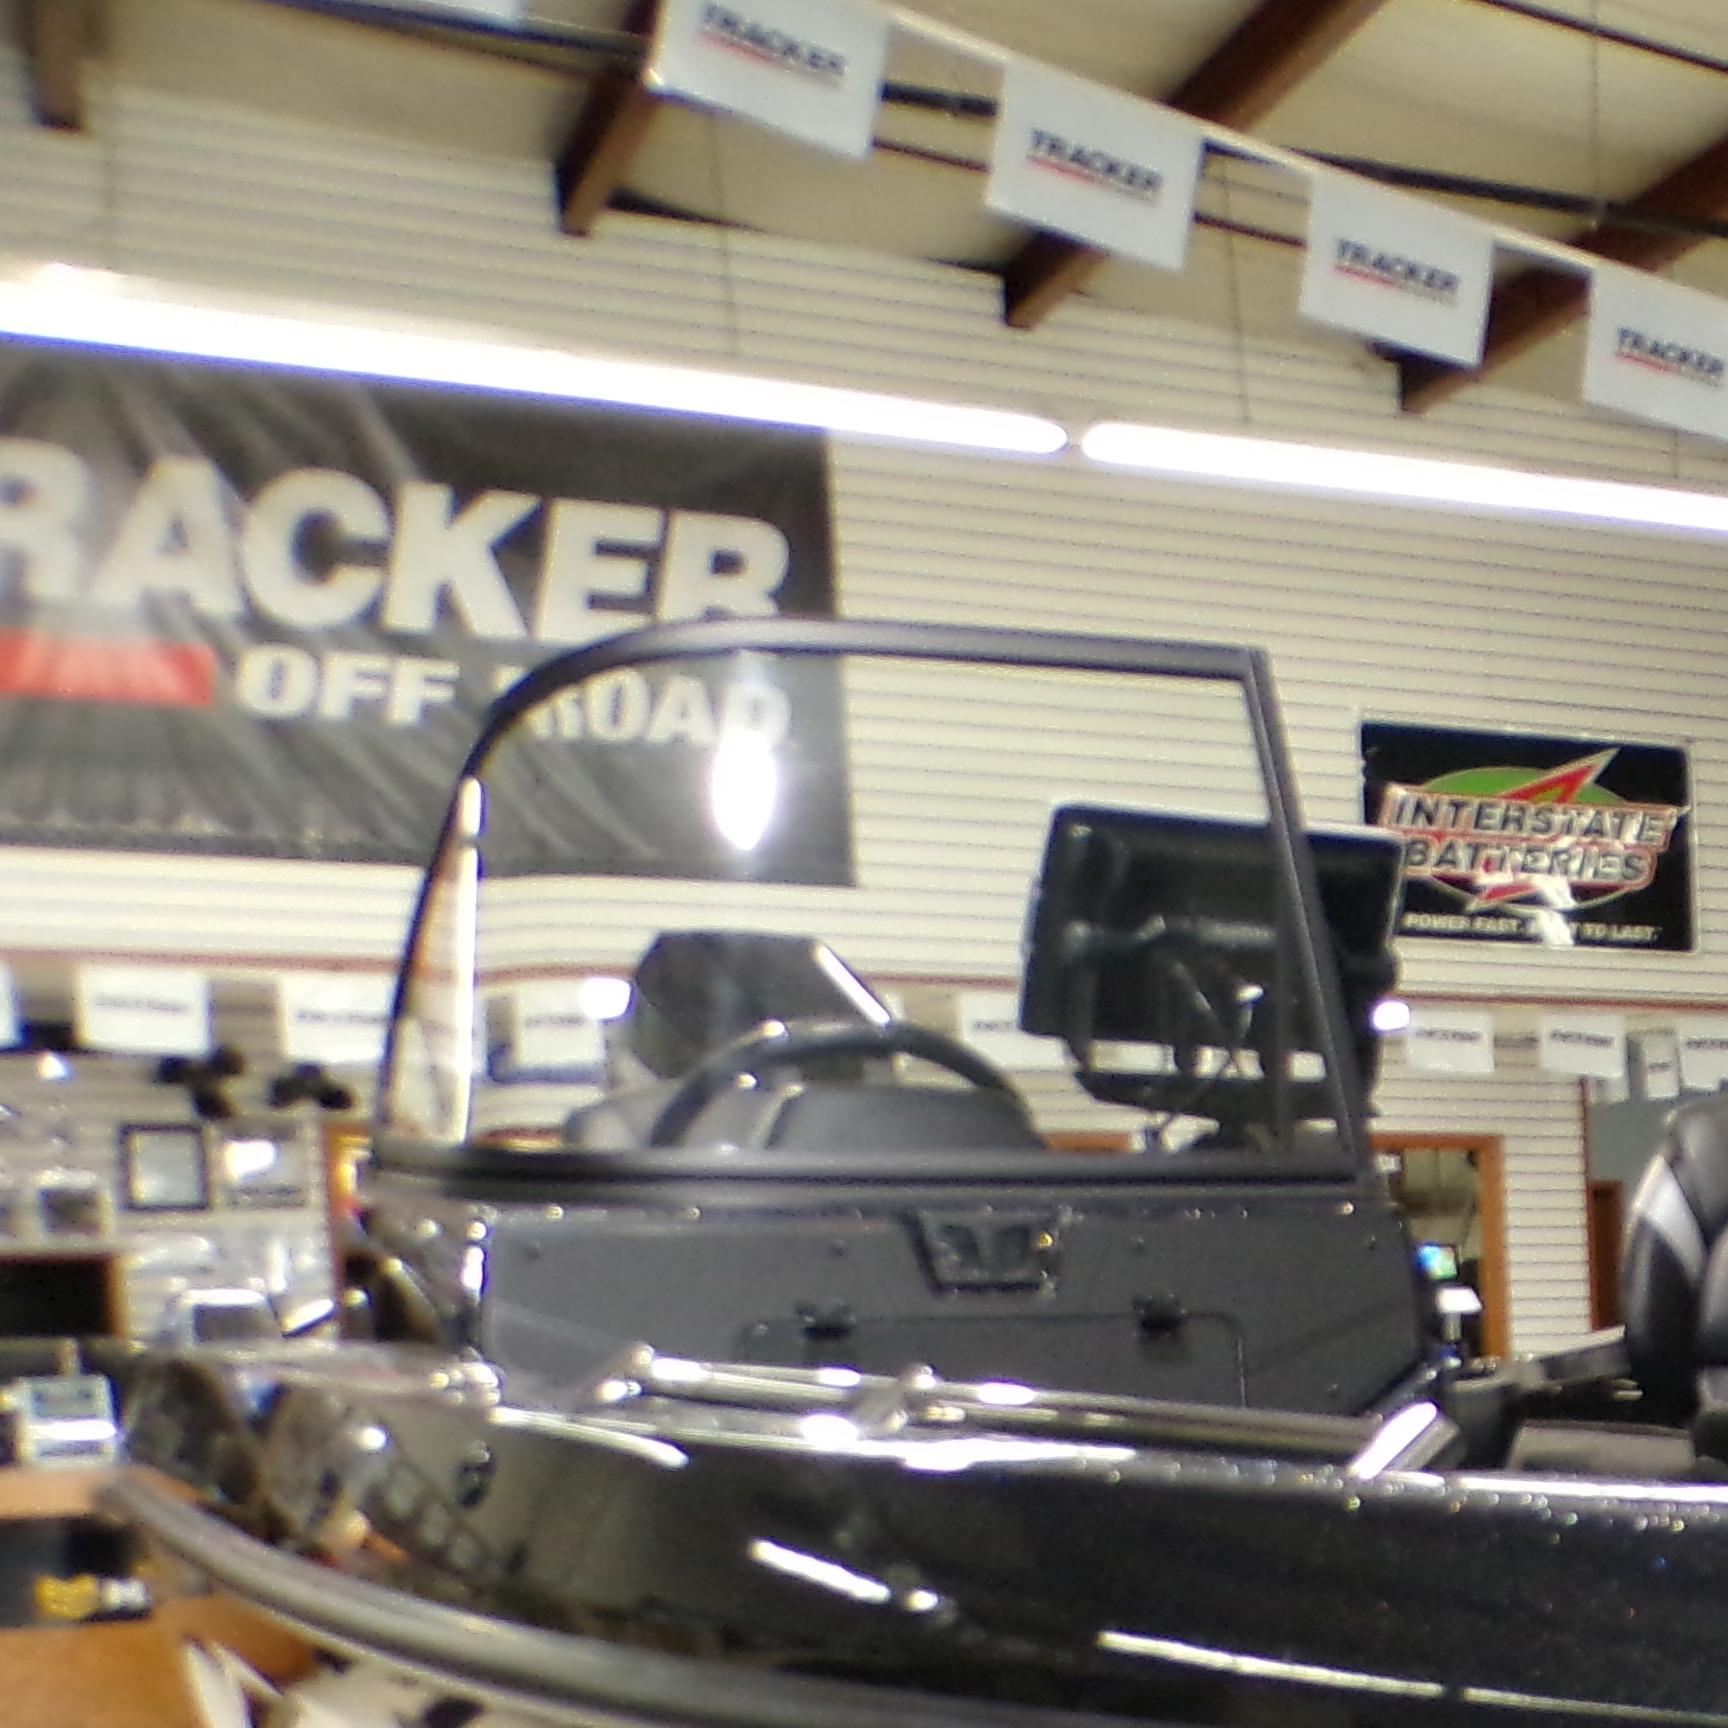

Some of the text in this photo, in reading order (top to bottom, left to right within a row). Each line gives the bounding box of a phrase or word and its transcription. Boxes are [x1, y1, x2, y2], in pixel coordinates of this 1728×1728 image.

[702, 4, 847, 77] TRACKER
[1029, 128, 1163, 191] TRACKER
[1334, 239, 1461, 294] TRACKER
[1616, 327, 1726, 376] TRACKER
[236, 644, 461, 728] OFF
[1396, 795, 1665, 843] INTERSTATE
[1402, 837, 1645, 881] BATTERIES
